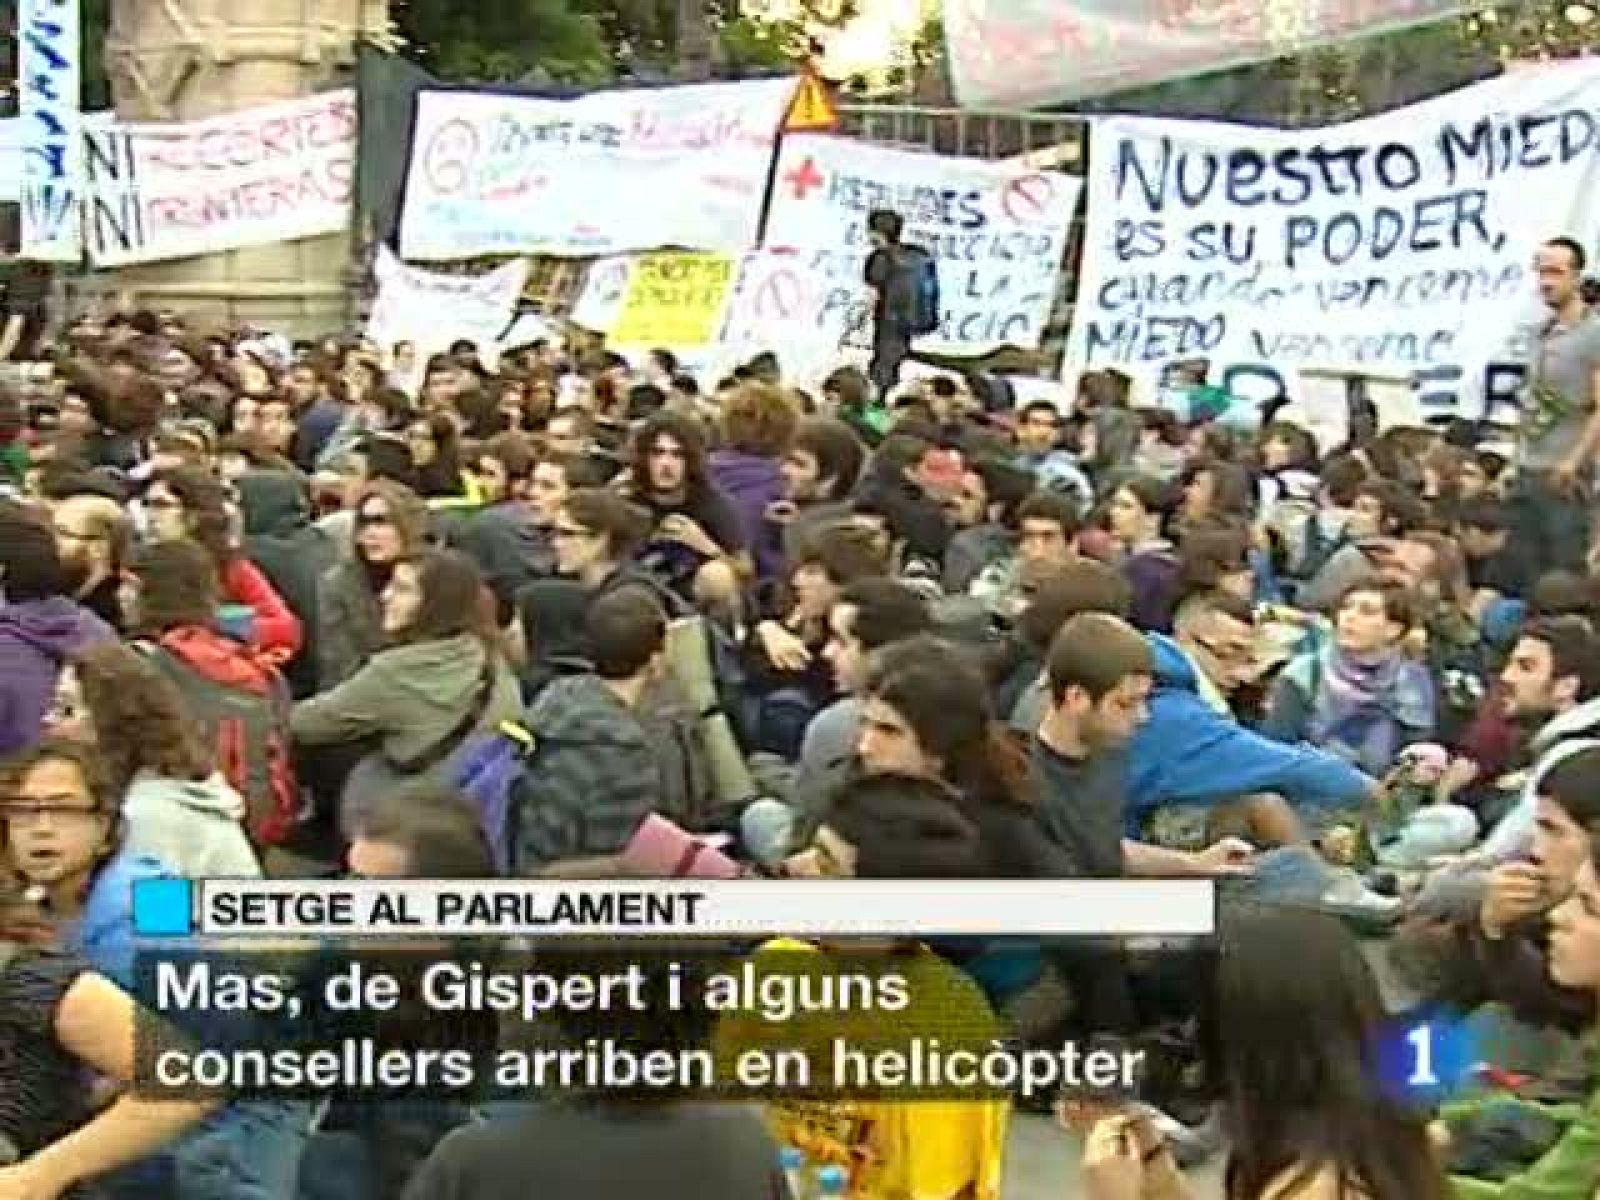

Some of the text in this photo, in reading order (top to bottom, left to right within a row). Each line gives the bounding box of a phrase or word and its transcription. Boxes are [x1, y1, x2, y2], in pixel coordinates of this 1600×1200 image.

[83, 128, 136, 181] NI
[1437, 108, 1599, 186] MIED
[93, 190, 145, 250] NI
